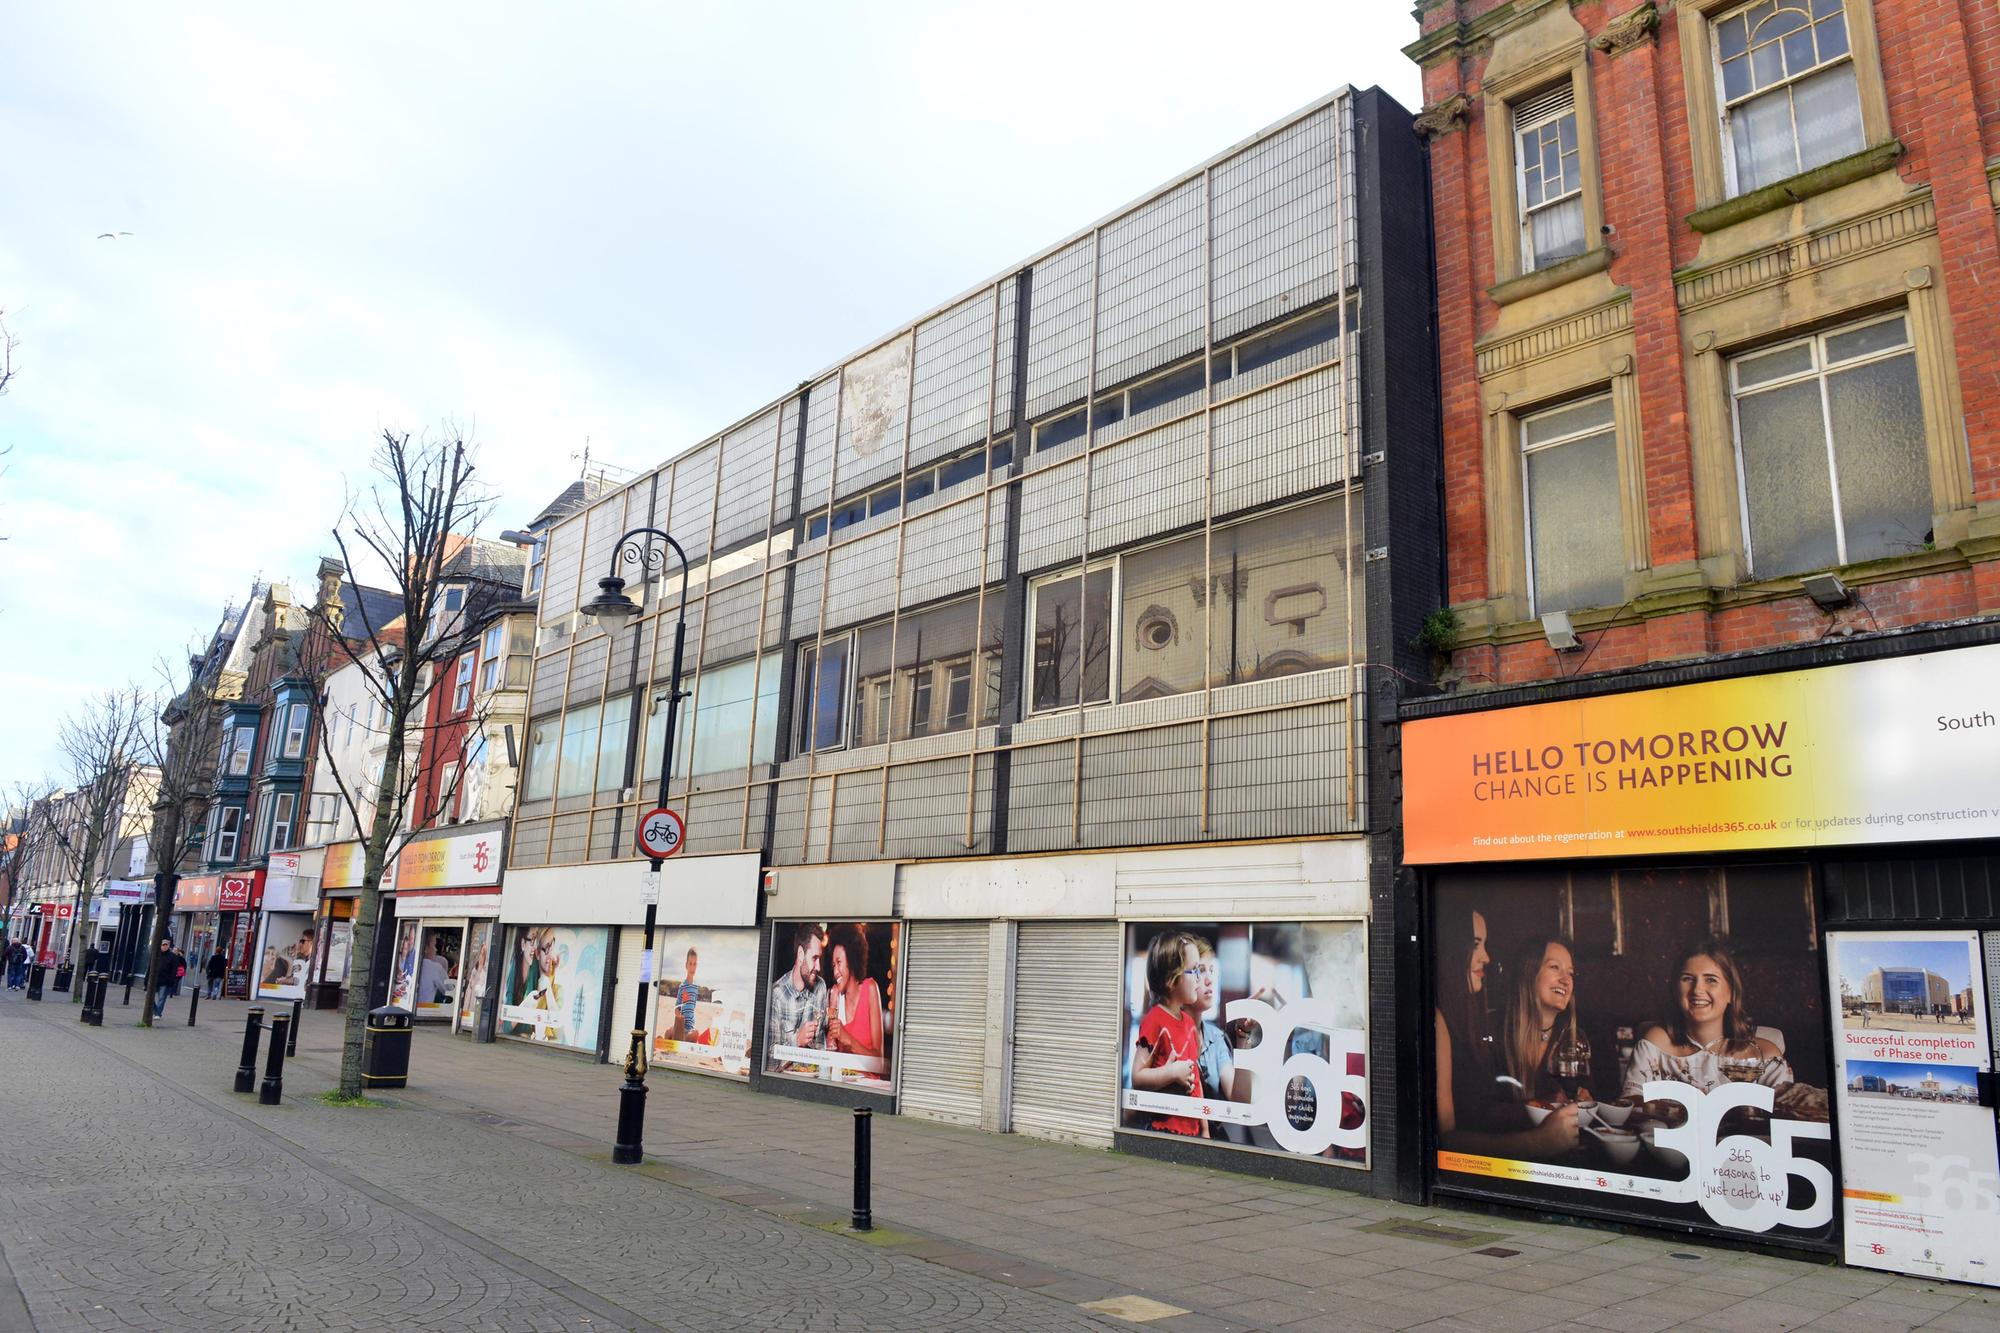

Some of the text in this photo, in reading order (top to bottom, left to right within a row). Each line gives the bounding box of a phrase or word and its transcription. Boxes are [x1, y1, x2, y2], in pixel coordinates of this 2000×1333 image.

[1936, 711, 1996, 731] South
[1473, 721, 1788, 776] HELLO TOMORROW
[1474, 754, 1792, 801] CHANGE IS HAPPENING
[1472, 836, 1491, 846] Find
[1492, 835, 1508, 845] out
[1509, 834, 1535, 844] about
[1537, 832, 1552, 843] the
[1554, 830, 1612, 844] regeneration
[1614, 829, 1624, 839] at
[1627, 819, 1777, 838] www.southshields365.co.uk
[1779, 819, 1793, 829] or
[1795, 817, 1813, 829] for
[1815, 813, 1862, 832] updates
[1864, 812, 1904, 826] during
[1906, 807, 1988, 822] construction
[1845, 1033, 1976, 1049] Successful completion
[1873, 1048, 1948, 1061] of Phase one
[1642, 1080, 1833, 1234] 365
[1728, 1148, 1753, 1163] 365
[1507, 1167, 1580, 1181] www.southshields365.co.uk
[1713, 1165, 1771, 1182] reasons to
[1731, 1182, 1765, 1201] catch
